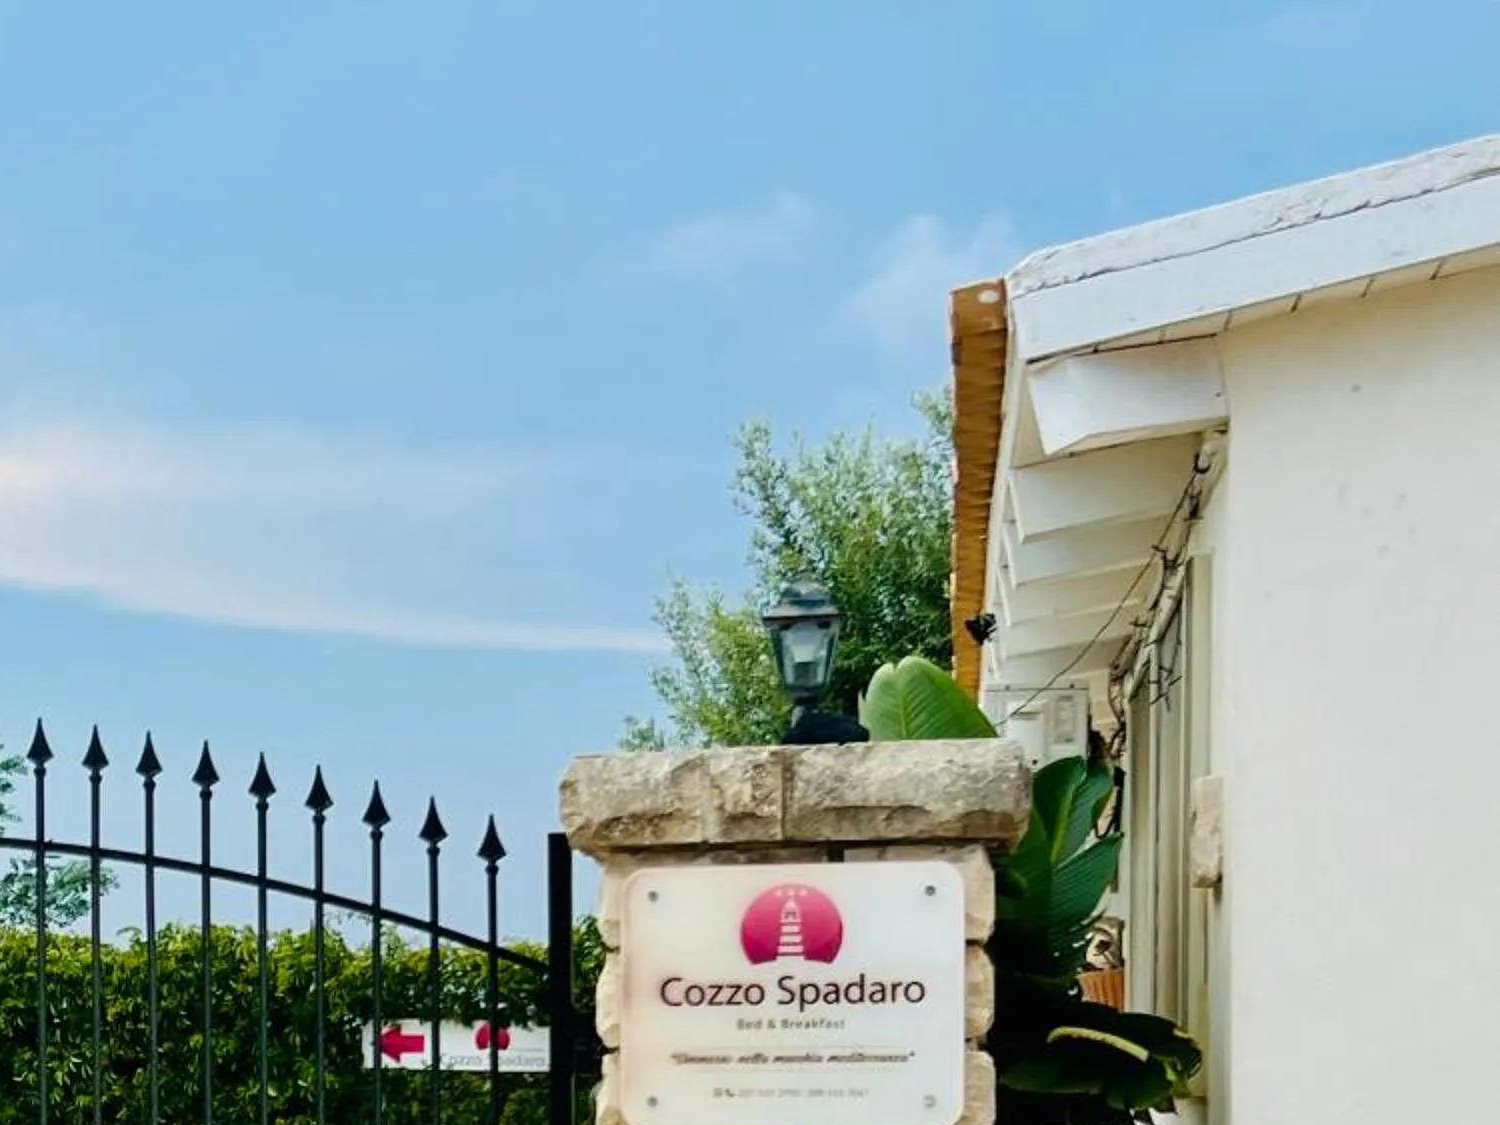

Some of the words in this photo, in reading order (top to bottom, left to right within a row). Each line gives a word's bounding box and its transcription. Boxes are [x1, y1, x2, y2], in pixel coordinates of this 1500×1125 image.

[660, 977, 765, 1007] Cozzo
[777, 973, 925, 1012] Spadaro
[736, 1018, 762, 1029] Bed
[780, 1018, 845, 1029] Breakfast
